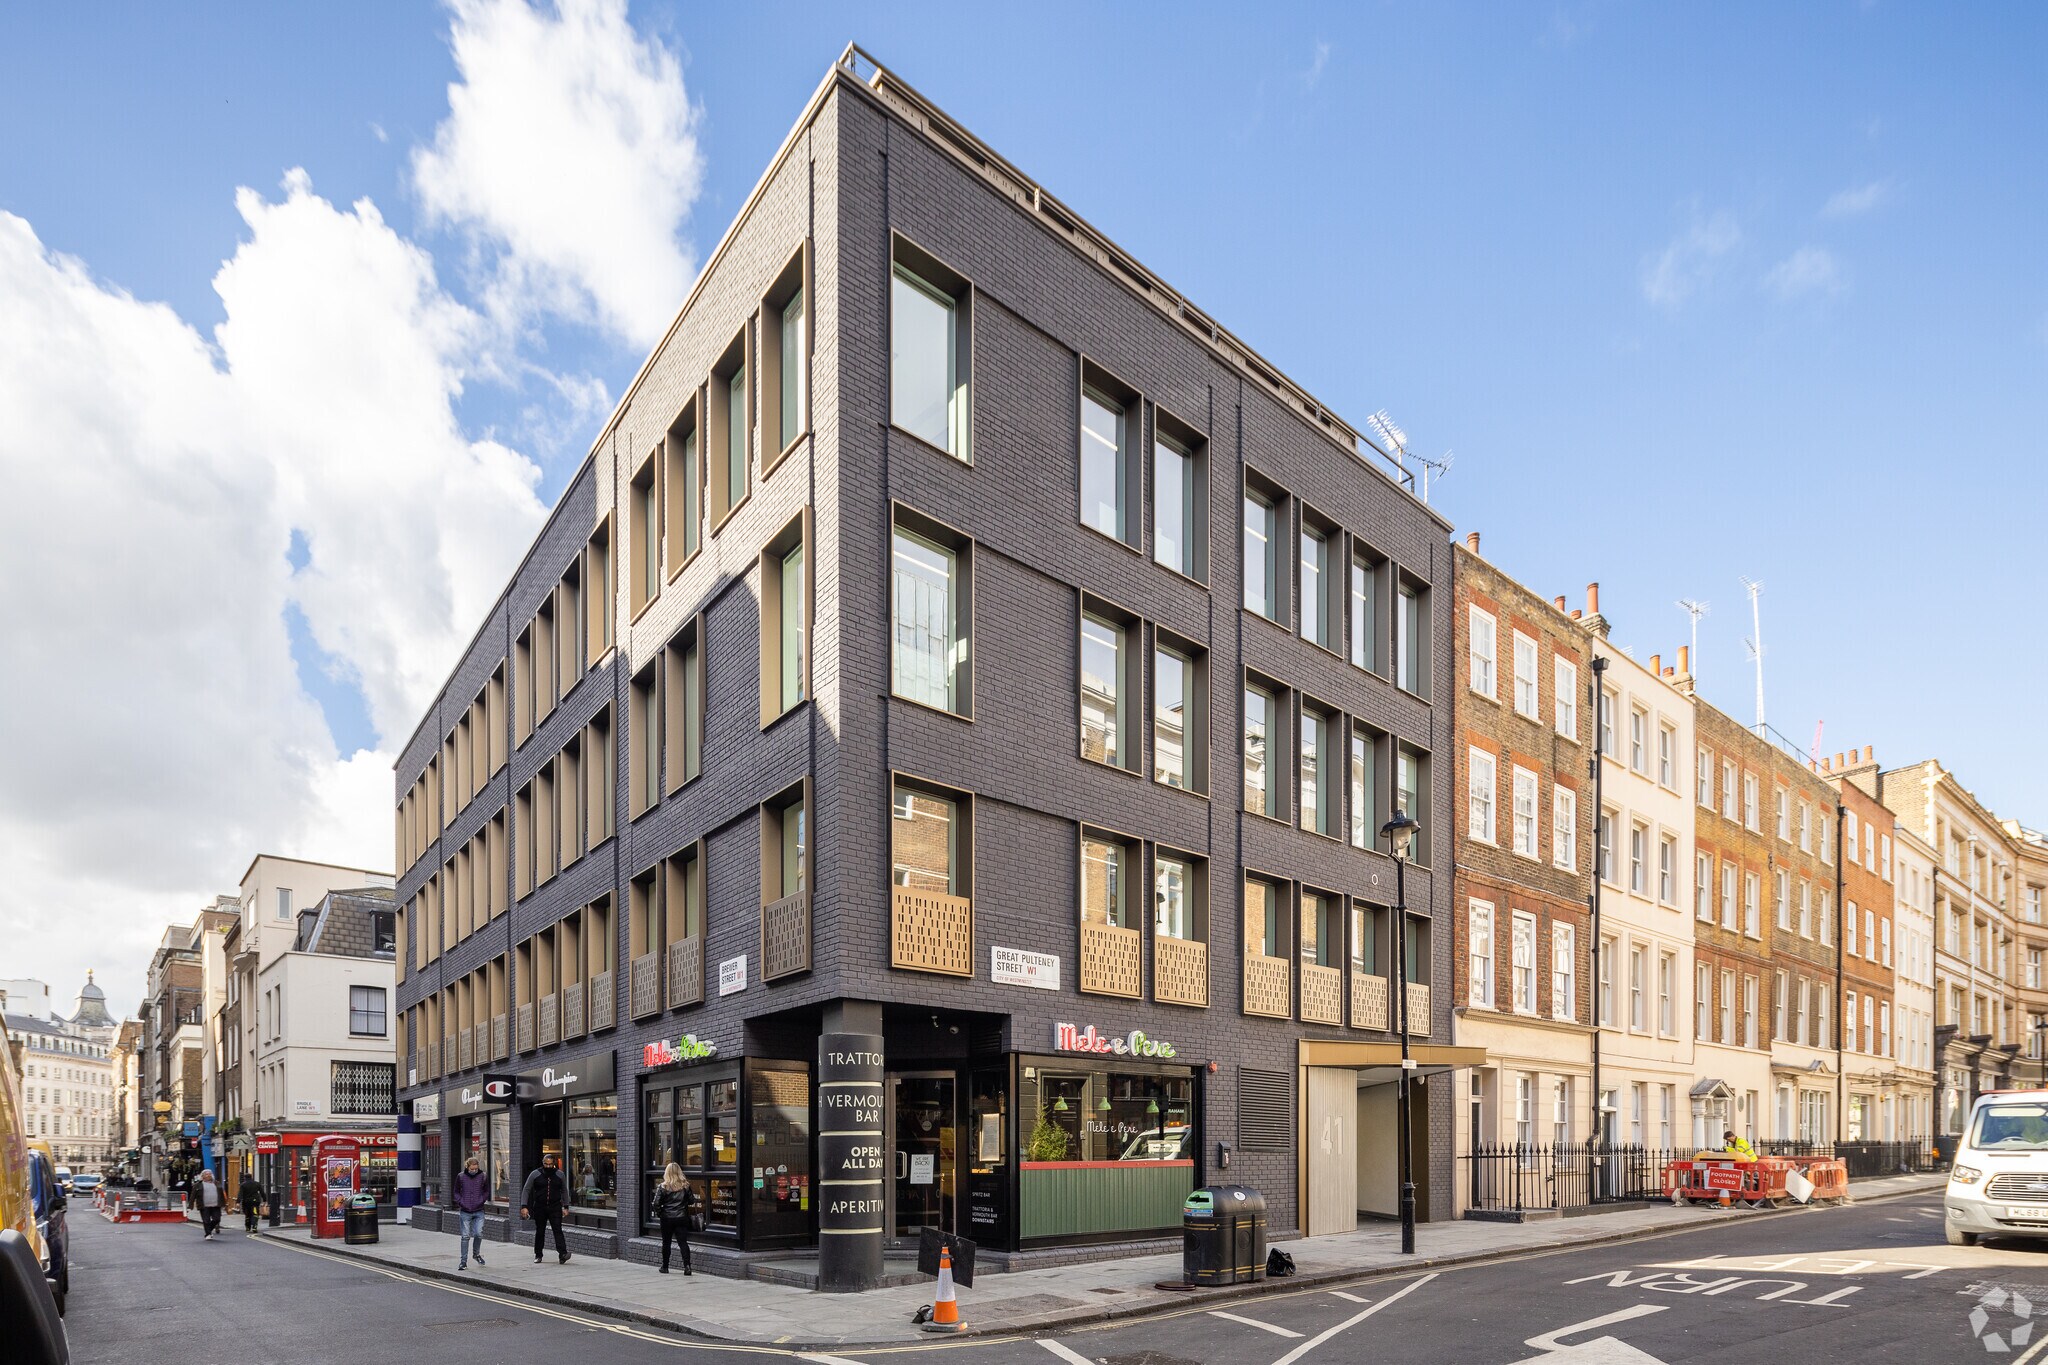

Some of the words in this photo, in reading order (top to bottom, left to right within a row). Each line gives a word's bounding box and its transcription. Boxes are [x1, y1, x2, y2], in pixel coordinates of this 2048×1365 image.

[996, 950, 1019, 962] GREAT
[1021, 954, 1055, 967] PULTENEY
[996, 961, 1023, 973] STREET
[1027, 965, 1037, 975] W1
[722, 973, 736, 985] STREET
[542, 1067, 578, 1095] Champion
[856, 1109, 879, 1122] BAR
[1086, 1120, 1110, 1132] Mele
[1118, 1121, 1138, 1133] Pere
[1320, 1115, 1344, 1155] 41
[851, 1146, 880, 1157] OPEN
[842, 1158, 866, 1169] ALL
[868, 1158, 884, 1168] DAY
[1562, 1270, 1865, 1308] TURN
